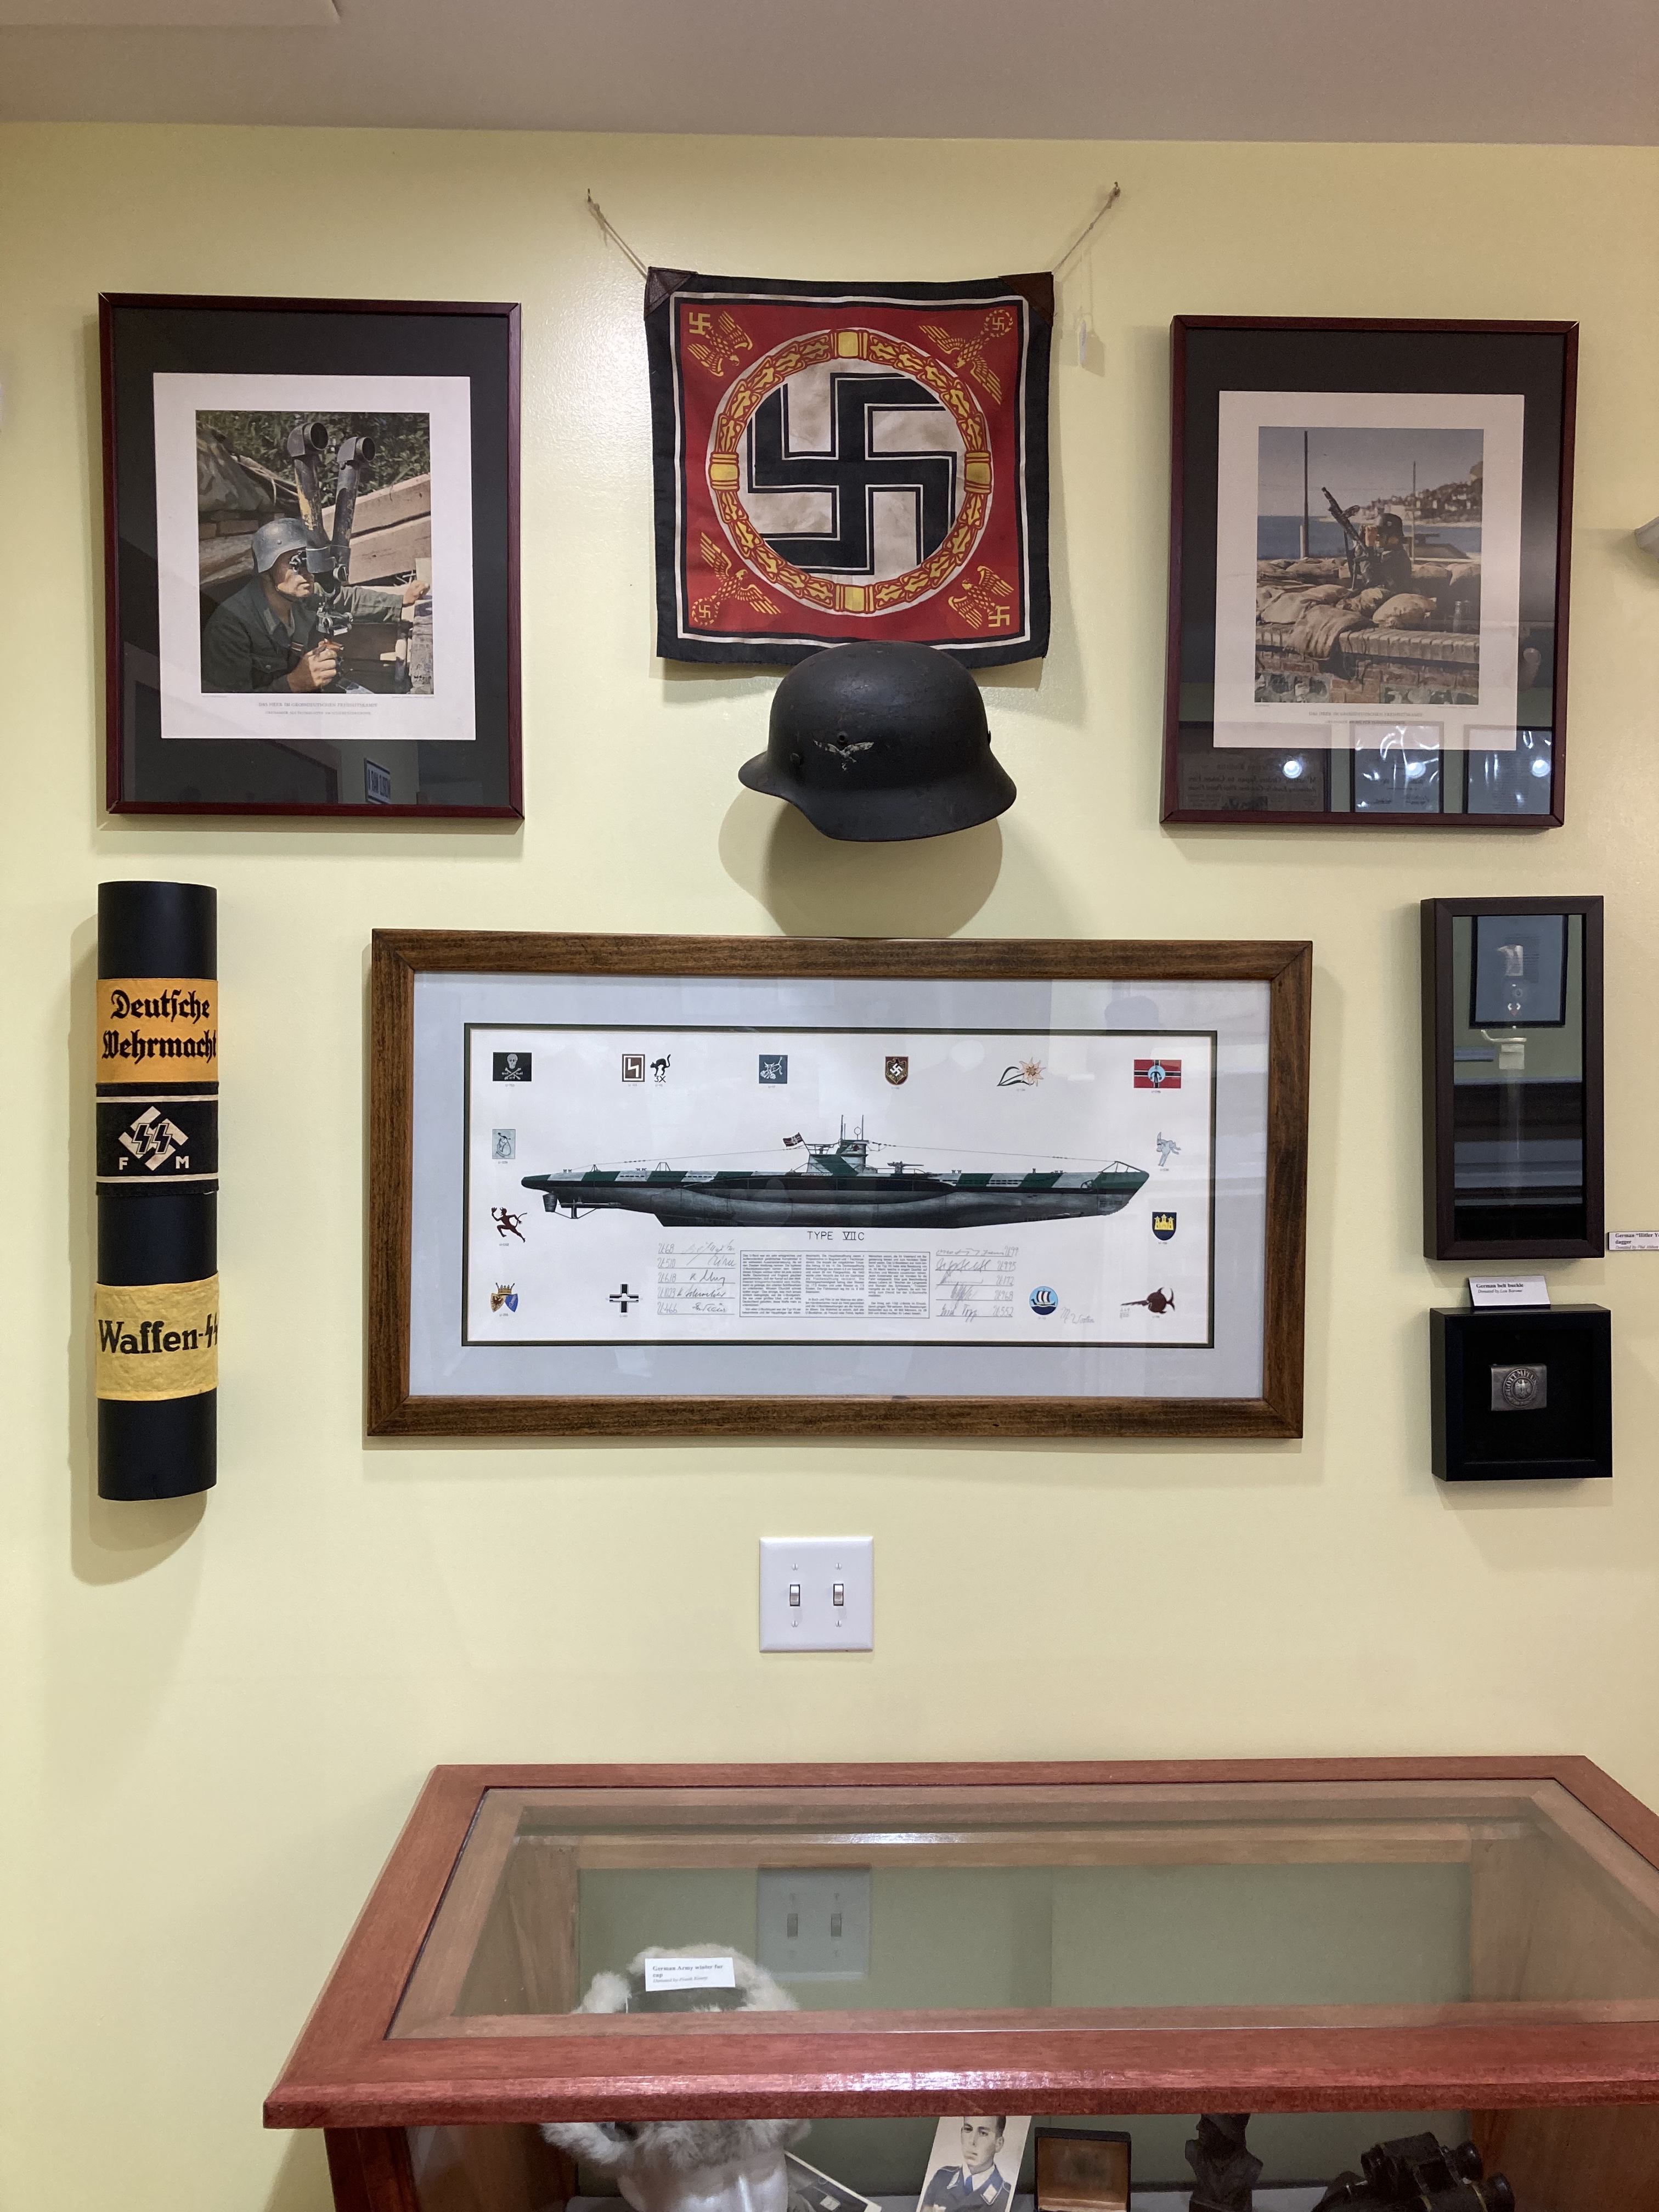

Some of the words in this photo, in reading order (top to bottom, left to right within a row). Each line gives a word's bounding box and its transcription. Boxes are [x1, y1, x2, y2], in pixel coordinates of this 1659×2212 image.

[119, 1156, 129, 1170] F
[176, 1155, 189, 1169] M
[807, 1231, 833, 1240] TYPE
